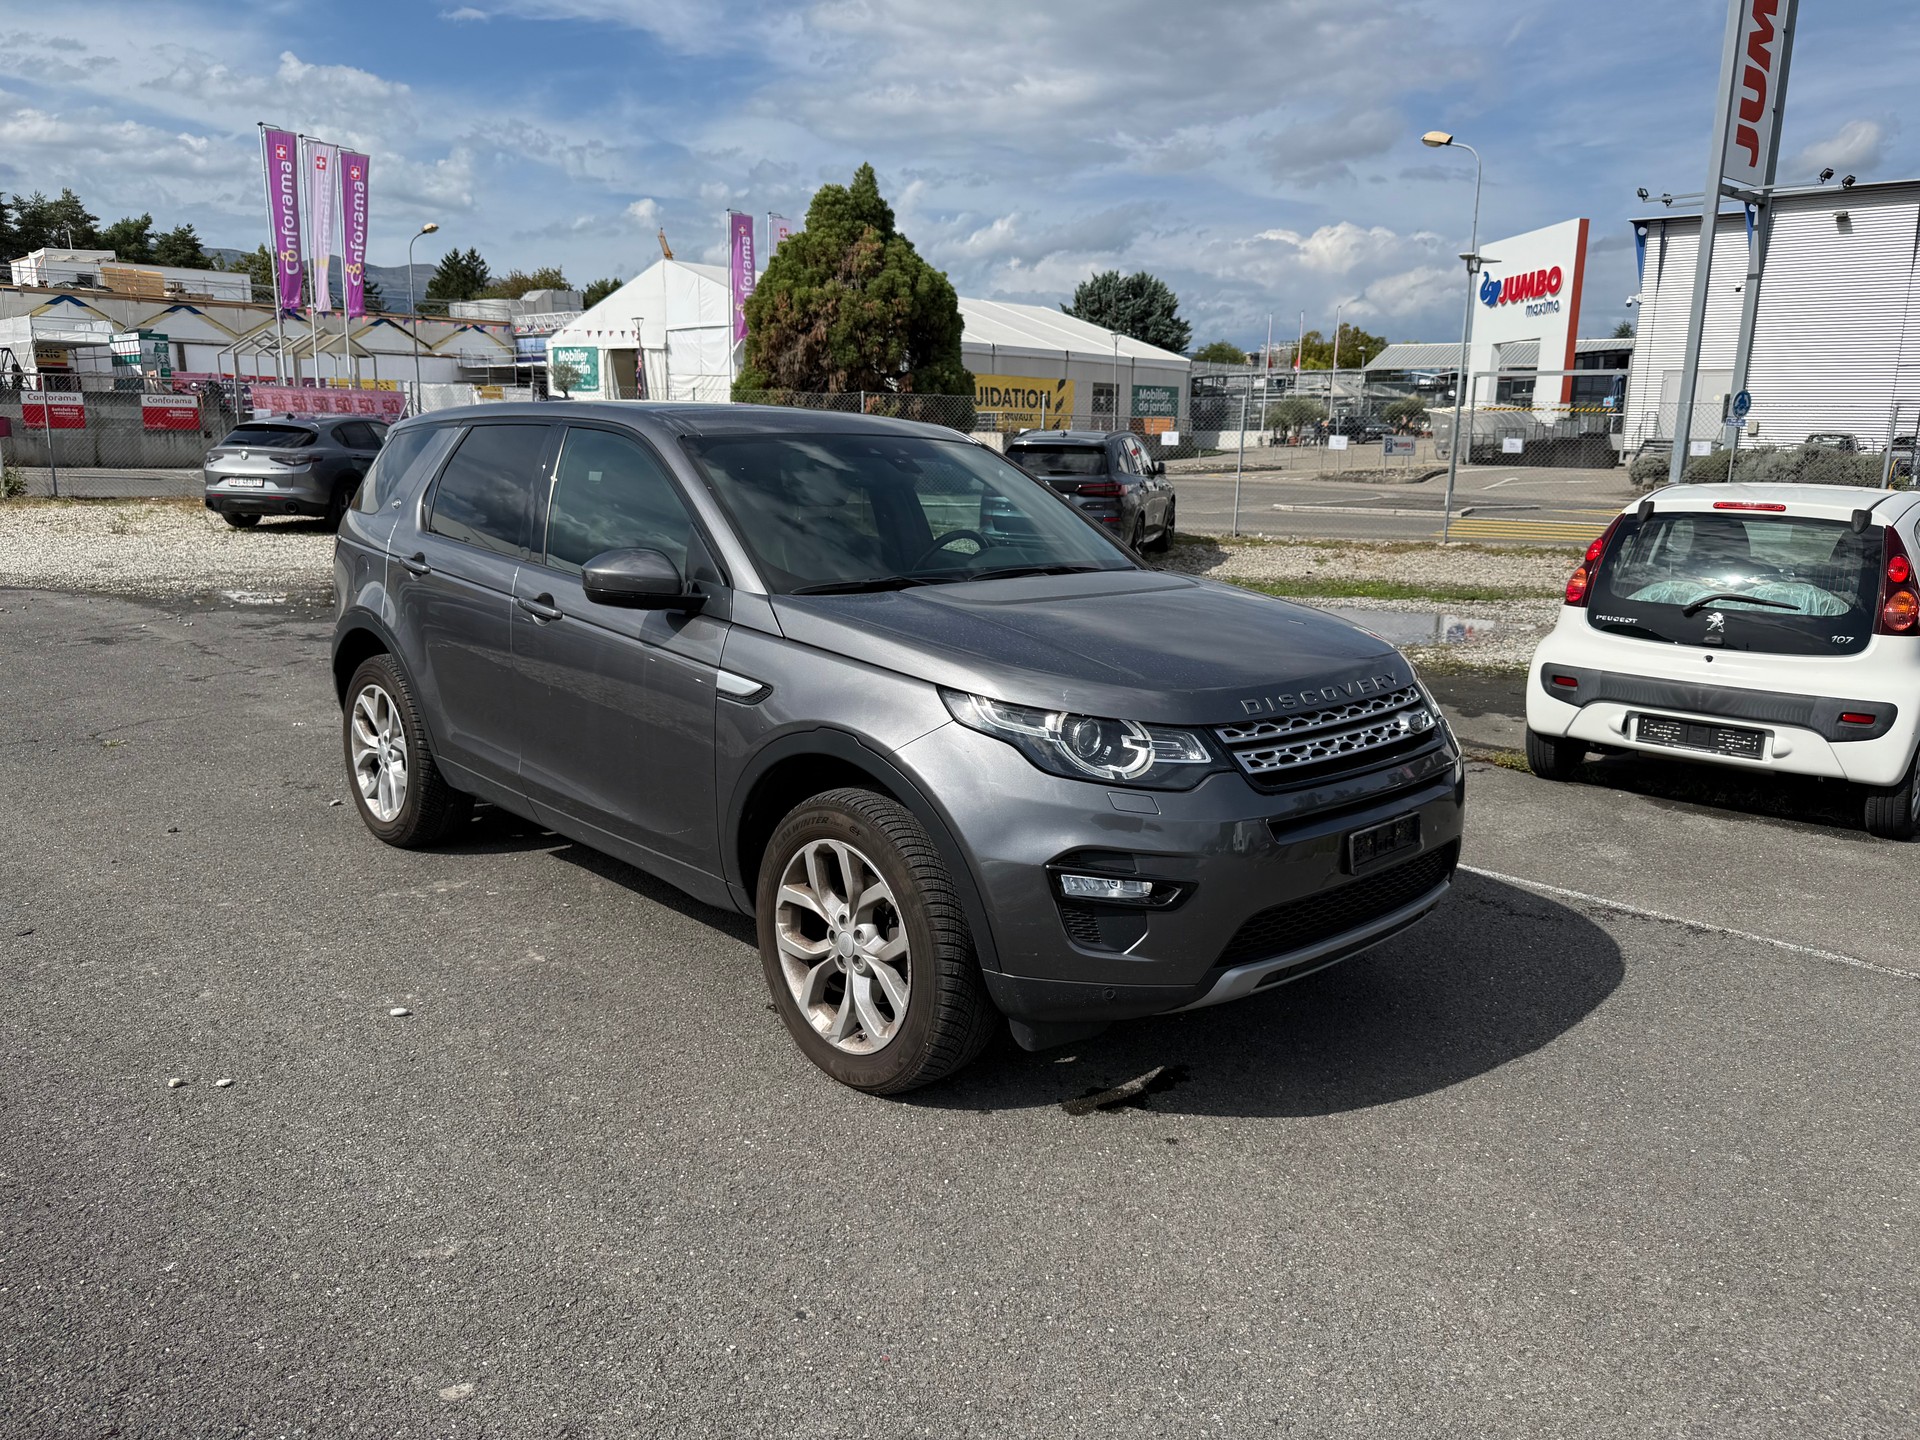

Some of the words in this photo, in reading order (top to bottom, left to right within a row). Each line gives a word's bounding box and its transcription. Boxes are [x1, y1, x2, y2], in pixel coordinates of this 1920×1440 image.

[281, 161, 300, 275] Conforama
[347, 181, 365, 286] Conforama
[1498, 266, 1563, 306] JUMBO
[558, 349, 588, 362] Mobilier
[27, 393, 77, 402] Conorama
[147, 396, 192, 405] Conforama
[1139, 388, 1170, 400] Mobilier
[1138, 401, 1149, 412] de
[1149, 400, 1172, 414] jardin
[1596, 615, 1637, 624] PEUGEOT
[1831, 635, 1854, 644] 107
[1240, 672, 1397, 715] DISCOVERY
